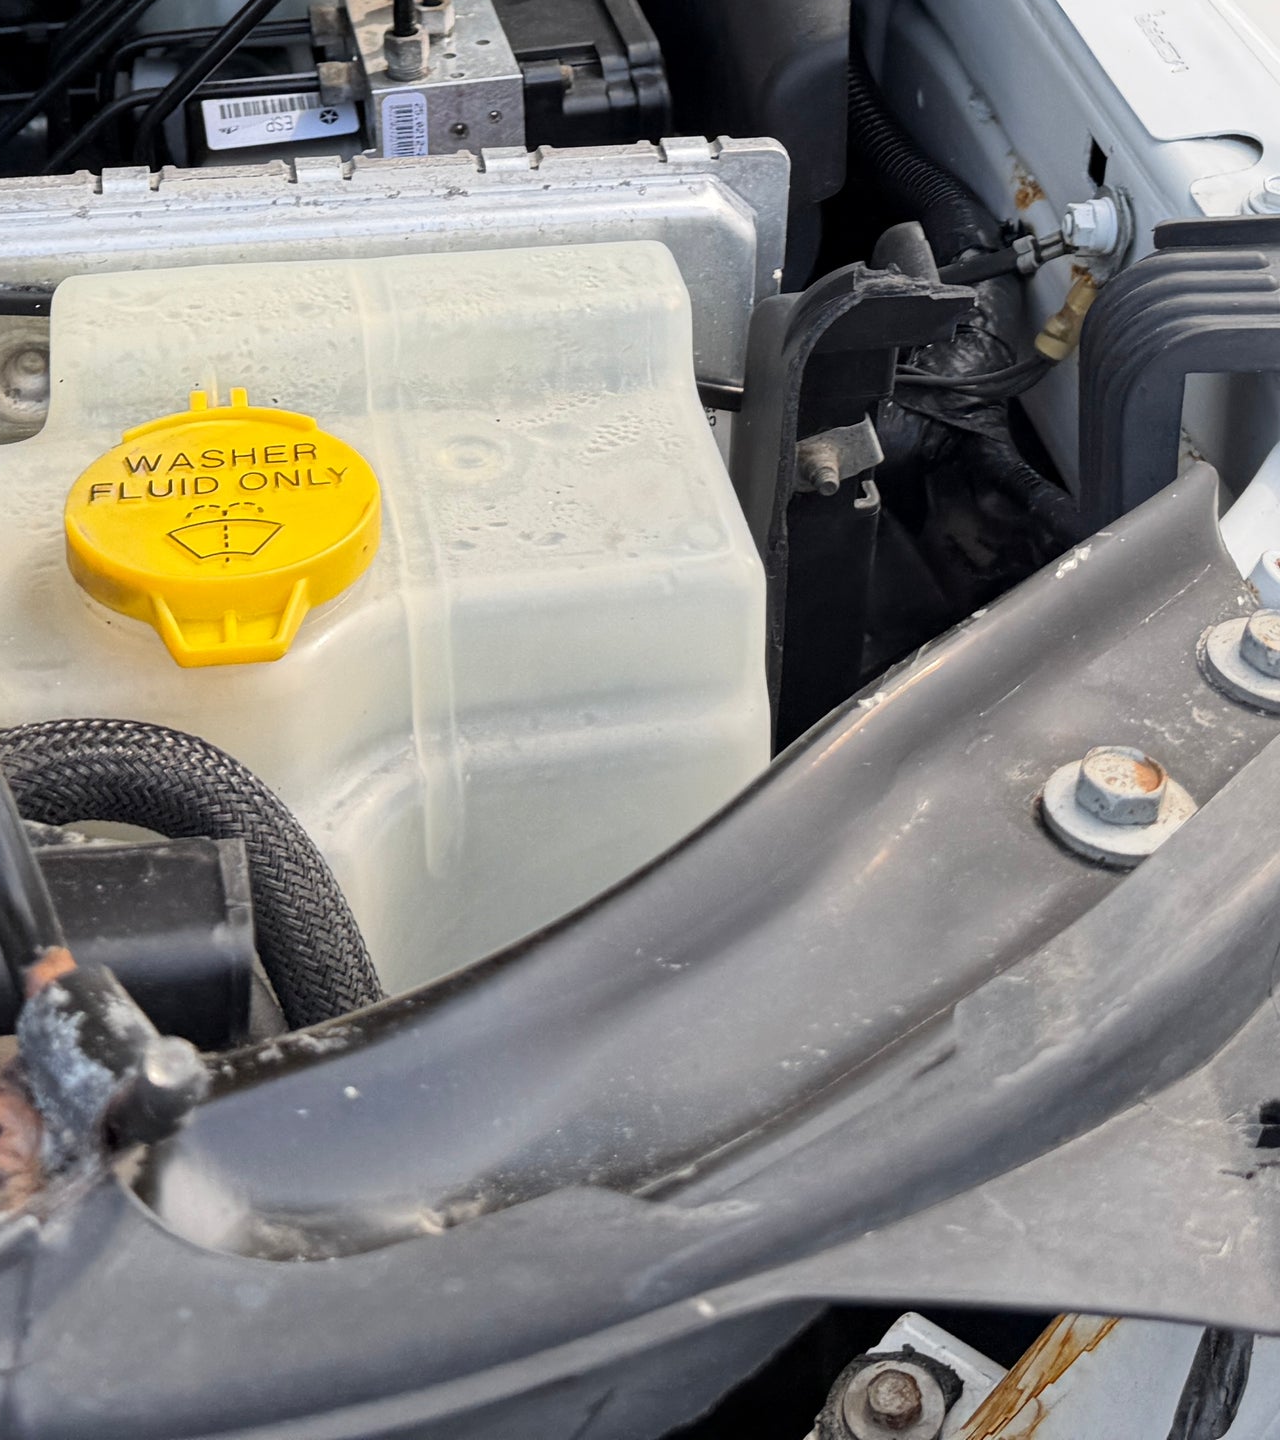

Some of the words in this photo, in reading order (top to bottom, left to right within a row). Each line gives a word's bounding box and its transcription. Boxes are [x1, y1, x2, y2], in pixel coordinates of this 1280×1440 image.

[265, 114, 294, 133] ESP
[122, 442, 318, 475] WASHER
[87, 475, 220, 505] FLUID
[238, 466, 349, 492] ONLY
